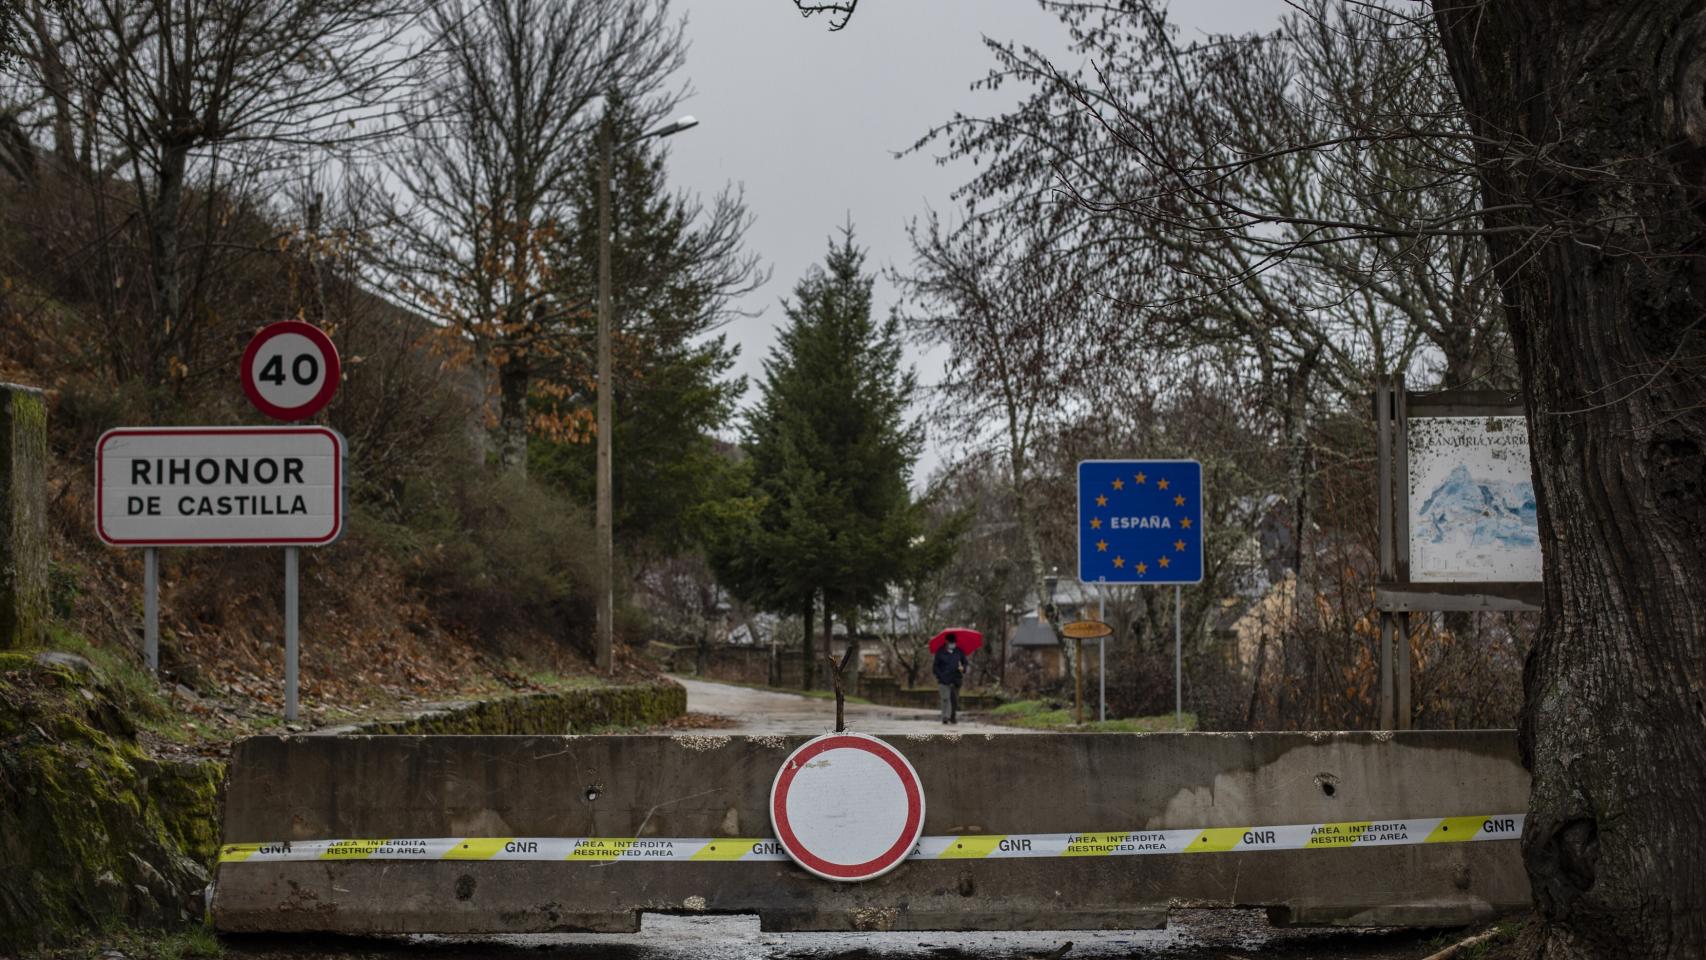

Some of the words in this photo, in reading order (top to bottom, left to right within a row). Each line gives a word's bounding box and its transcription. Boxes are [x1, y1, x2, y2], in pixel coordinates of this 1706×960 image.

[258, 353, 319, 386] 40
[131, 457, 304, 485] RIHONOR
[127, 496, 161, 516] DE
[177, 495, 308, 516] CASTILLA
[1111, 515, 1172, 529] ESPAÑA
[1310, 825, 1340, 835] ÁREA
[1349, 823, 1407, 833] INTERDITA
[1482, 819, 1515, 833] GNR
[1067, 834, 1098, 844] ÁREA
[1106, 834, 1166, 843] INTERDITA
[1242, 831, 1276, 845] GNR
[1311, 833, 1377, 844] RESTRICTED
[1379, 832, 1408, 841] AREA
[505, 842, 538, 853] GNR
[999, 839, 1032, 852] GNR
[1067, 844, 1135, 852] RESTRICTED
[644, 849, 674, 857] AREA
